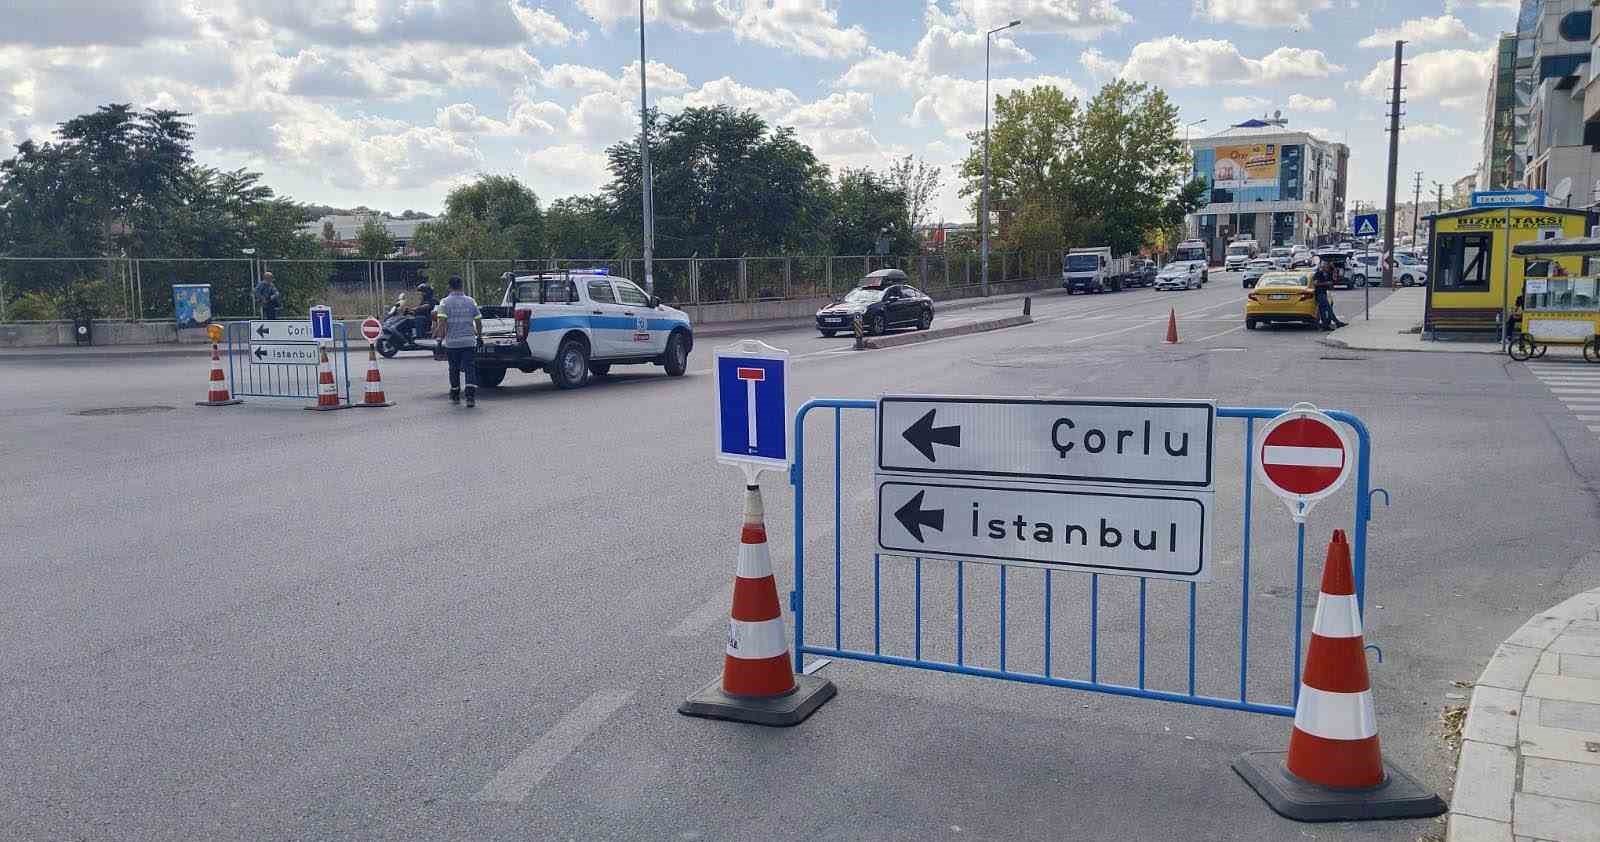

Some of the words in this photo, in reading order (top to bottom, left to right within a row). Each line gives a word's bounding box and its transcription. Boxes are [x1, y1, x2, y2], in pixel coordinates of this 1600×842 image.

[287, 325, 312, 336] Çorl
[1051, 417, 1189, 459] Çorlu
[971, 502, 1177, 553] İstanbul
